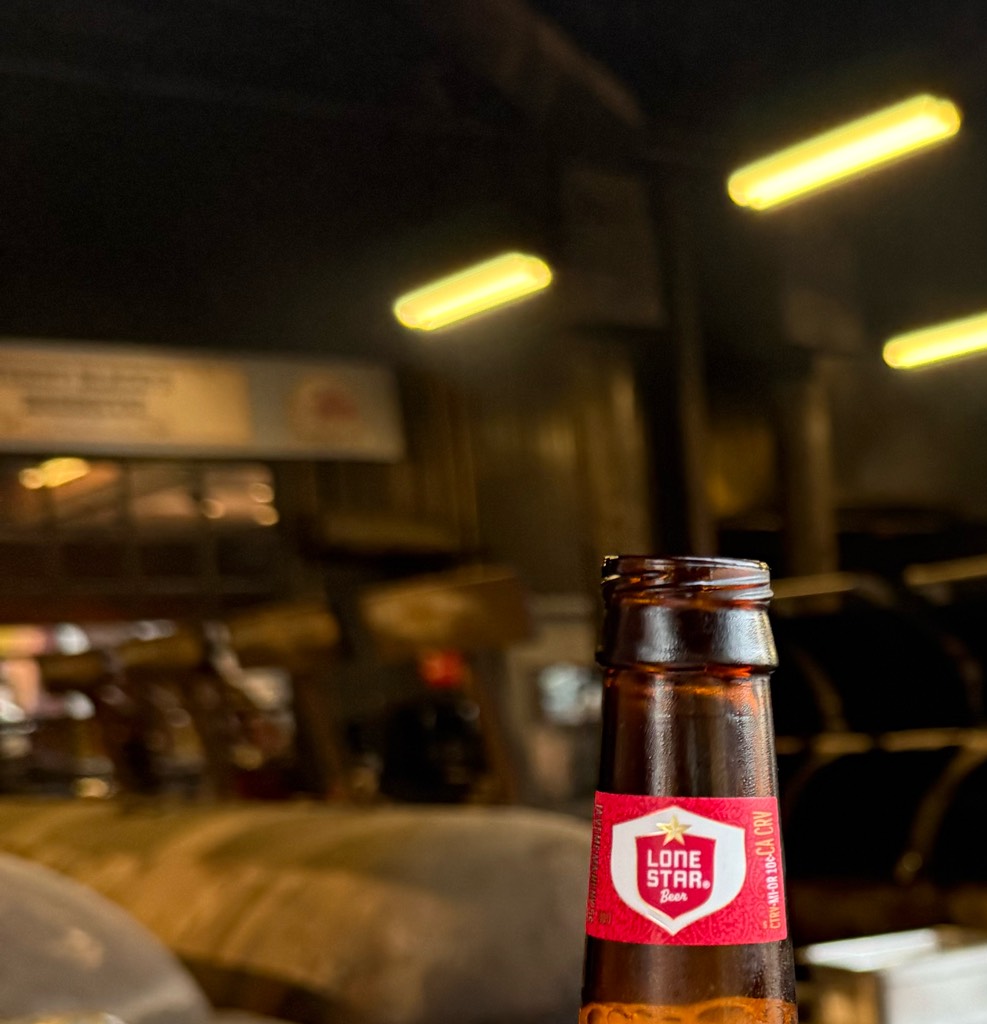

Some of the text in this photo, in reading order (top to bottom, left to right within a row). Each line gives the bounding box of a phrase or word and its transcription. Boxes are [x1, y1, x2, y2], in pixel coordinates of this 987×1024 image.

[752, 811, 774, 836] CRV
[647, 849, 702, 869] LONE
[660, 888, 689, 904] Beer
